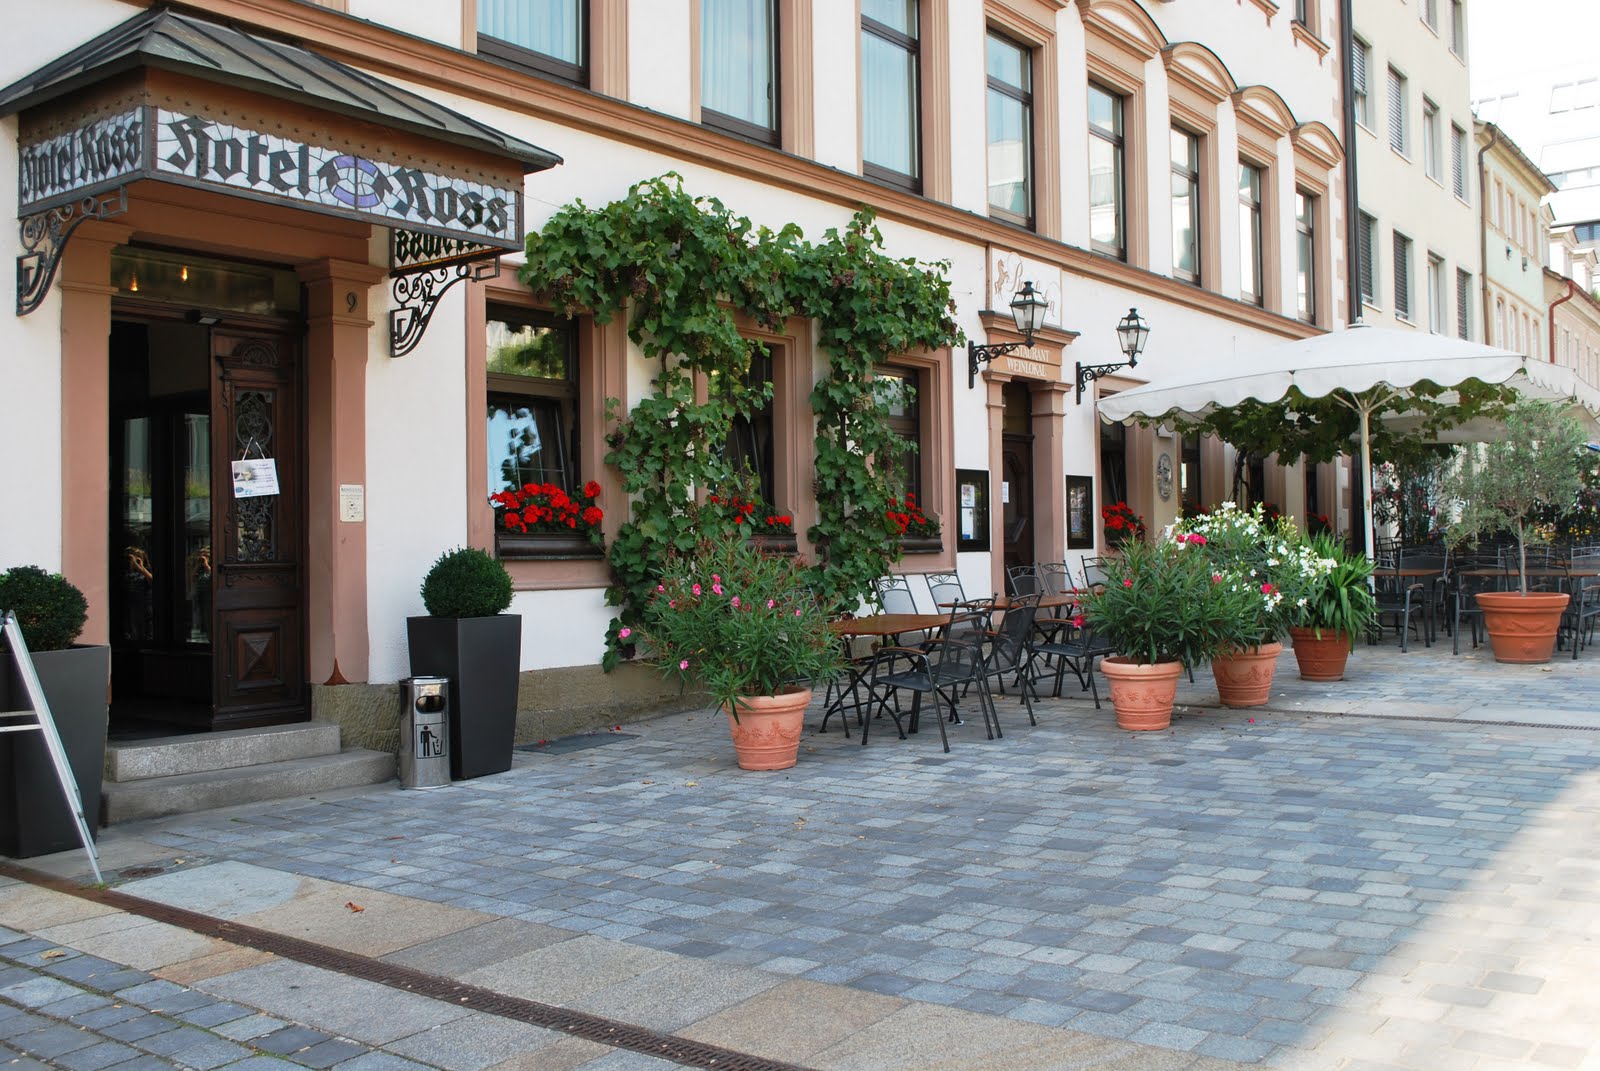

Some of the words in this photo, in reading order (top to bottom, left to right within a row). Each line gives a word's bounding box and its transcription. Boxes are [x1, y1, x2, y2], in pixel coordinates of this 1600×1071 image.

[22, 132, 76, 200] Hotel
[79, 121, 142, 183] Ross
[167, 116, 311, 199] Hotel
[387, 166, 508, 234] Ross
[346, 291, 358, 313] 9
[1006, 356, 1047, 377] WEINLOKAL
